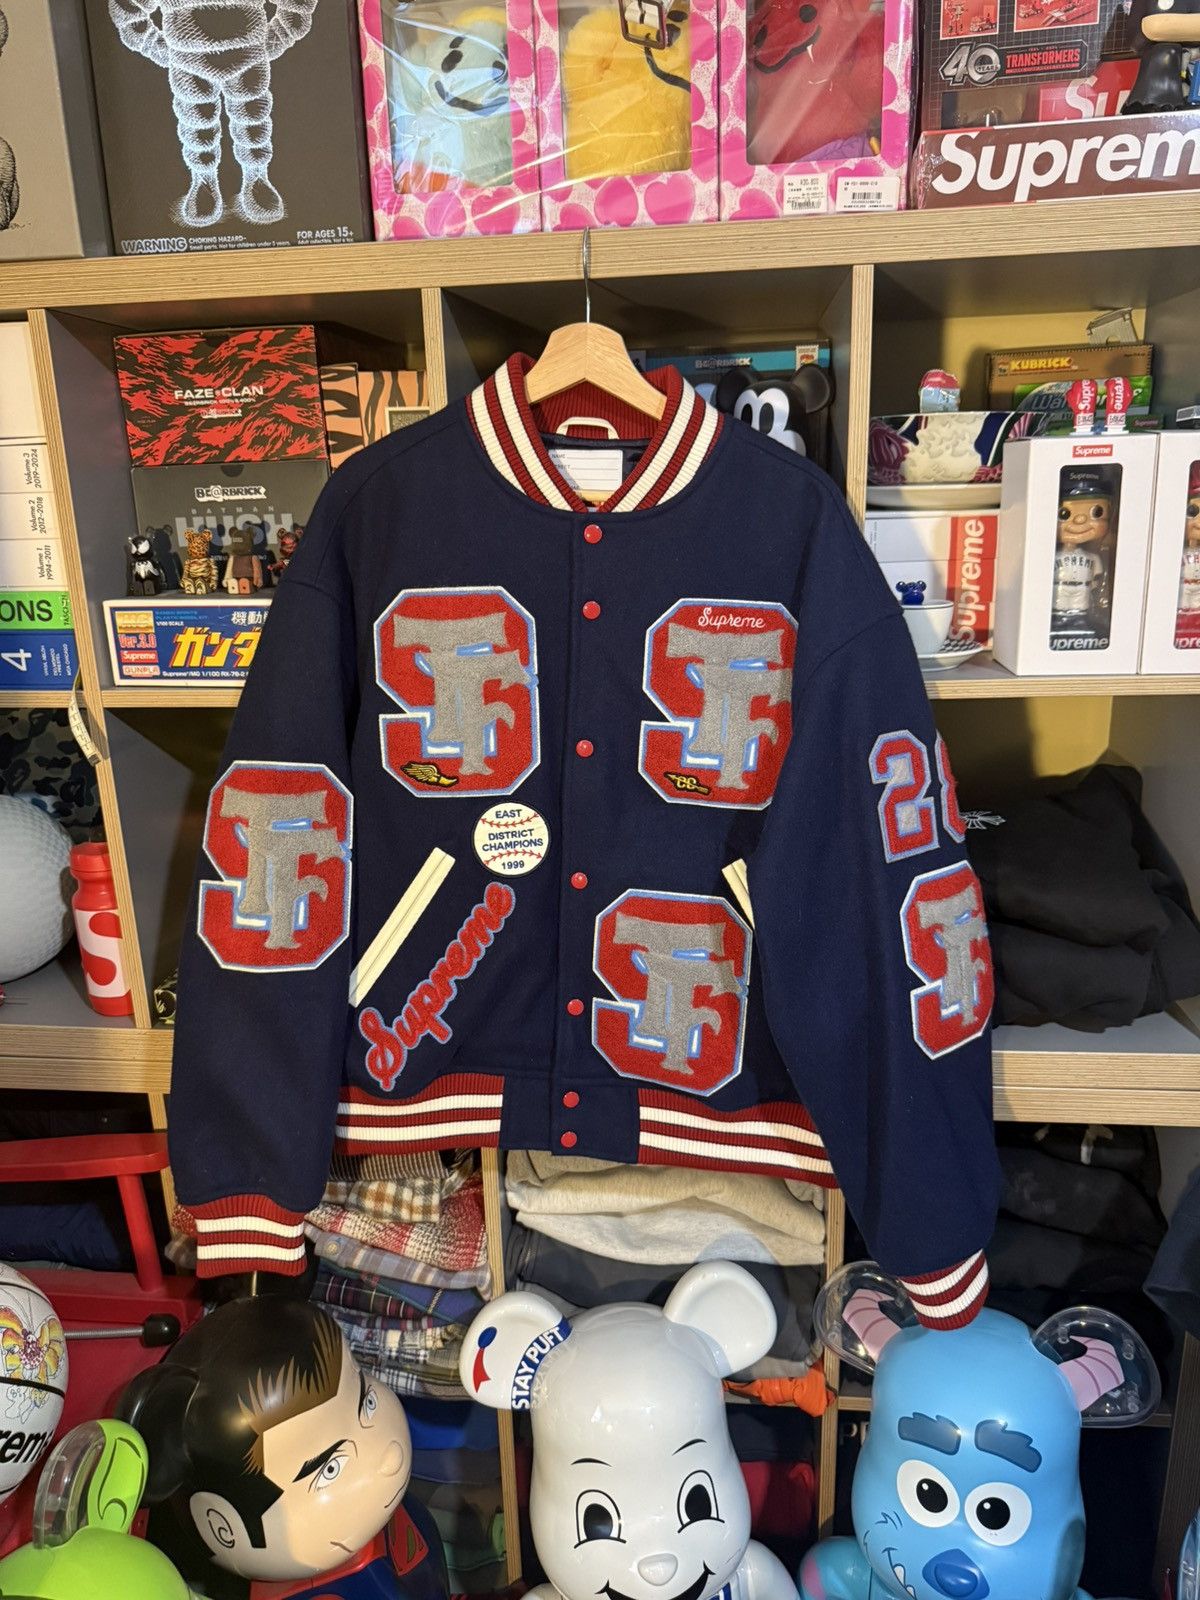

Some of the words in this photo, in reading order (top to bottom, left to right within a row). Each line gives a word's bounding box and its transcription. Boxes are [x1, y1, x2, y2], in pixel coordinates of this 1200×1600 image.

[1005, 48, 1080, 69] TRANSFORMERS
[188, 236, 217, 244] CHOKING
[297, 230, 313, 240] FOR
[315, 229, 336, 239] AGES
[336, 226, 354, 238] 15+
[121, 236, 188, 254] WARNING
[1010, 356, 1072, 371] KUBRICK
[174, 388, 215, 400] FAZE
[221, 385, 264, 397] CLAN
[1074, 446, 1111, 458] Supreme
[24, 459, 33, 486] Volume
[195, 485, 266, 502] BE@RBRICK
[28, 506, 38, 532] Volume
[175, 512, 294, 548] HUSH
[949, 518, 986, 644] Supreme
[0, 599, 53, 622] ONS
[230, 610, 268, 626] 機動
[698, 607, 767, 631] Supreme
[1, 648, 32, 672] 4
[122, 650, 157, 662] Supreme
[124, 665, 160, 675] GUNPLA
[495, 809, 522, 819] EAST
[488, 828, 535, 841] DISTRICT
[482, 838, 544, 852] CHAMPIONS
[501, 860, 525, 870] 1999
[359, 881, 516, 1092] Supreme
[511, 1360, 536, 1410] STAY
[525, 1326, 565, 1364] PUFT
